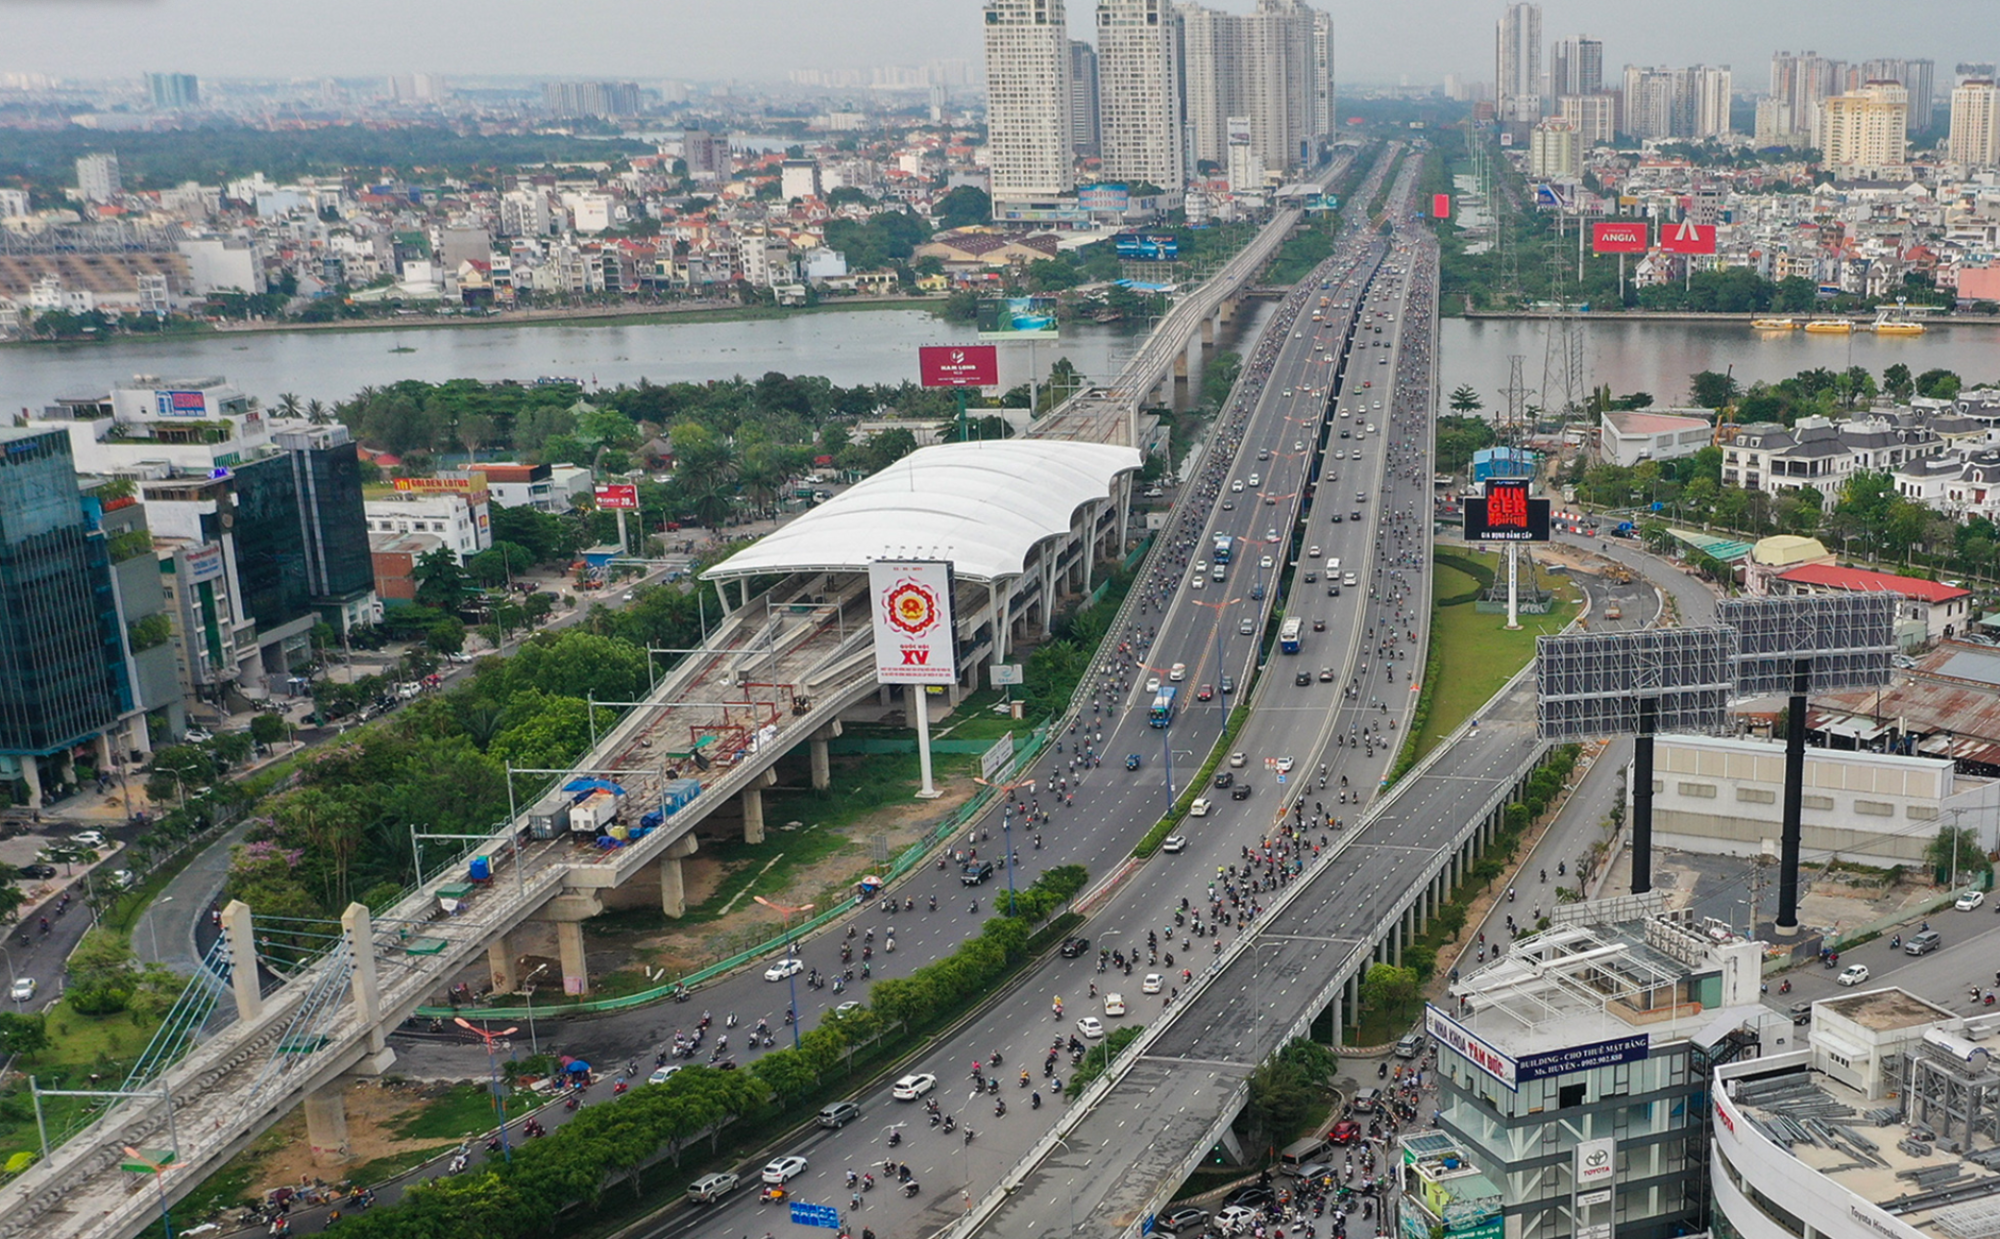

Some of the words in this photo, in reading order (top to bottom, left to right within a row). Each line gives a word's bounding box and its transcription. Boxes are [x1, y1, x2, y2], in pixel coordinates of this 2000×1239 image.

[411, 479, 442, 487] GOLDEN
[444, 479, 469, 487] LOTUS
[900, 650, 930, 665] XV
[1449, 1028, 1466, 1055] KHOA
[1468, 1041, 1486, 1067] TÂM
[1520, 1056, 1559, 1069] BUILDING
[1583, 1165, 1610, 1177] TOYOTA
[1851, 1205, 1871, 1226] Toyota
